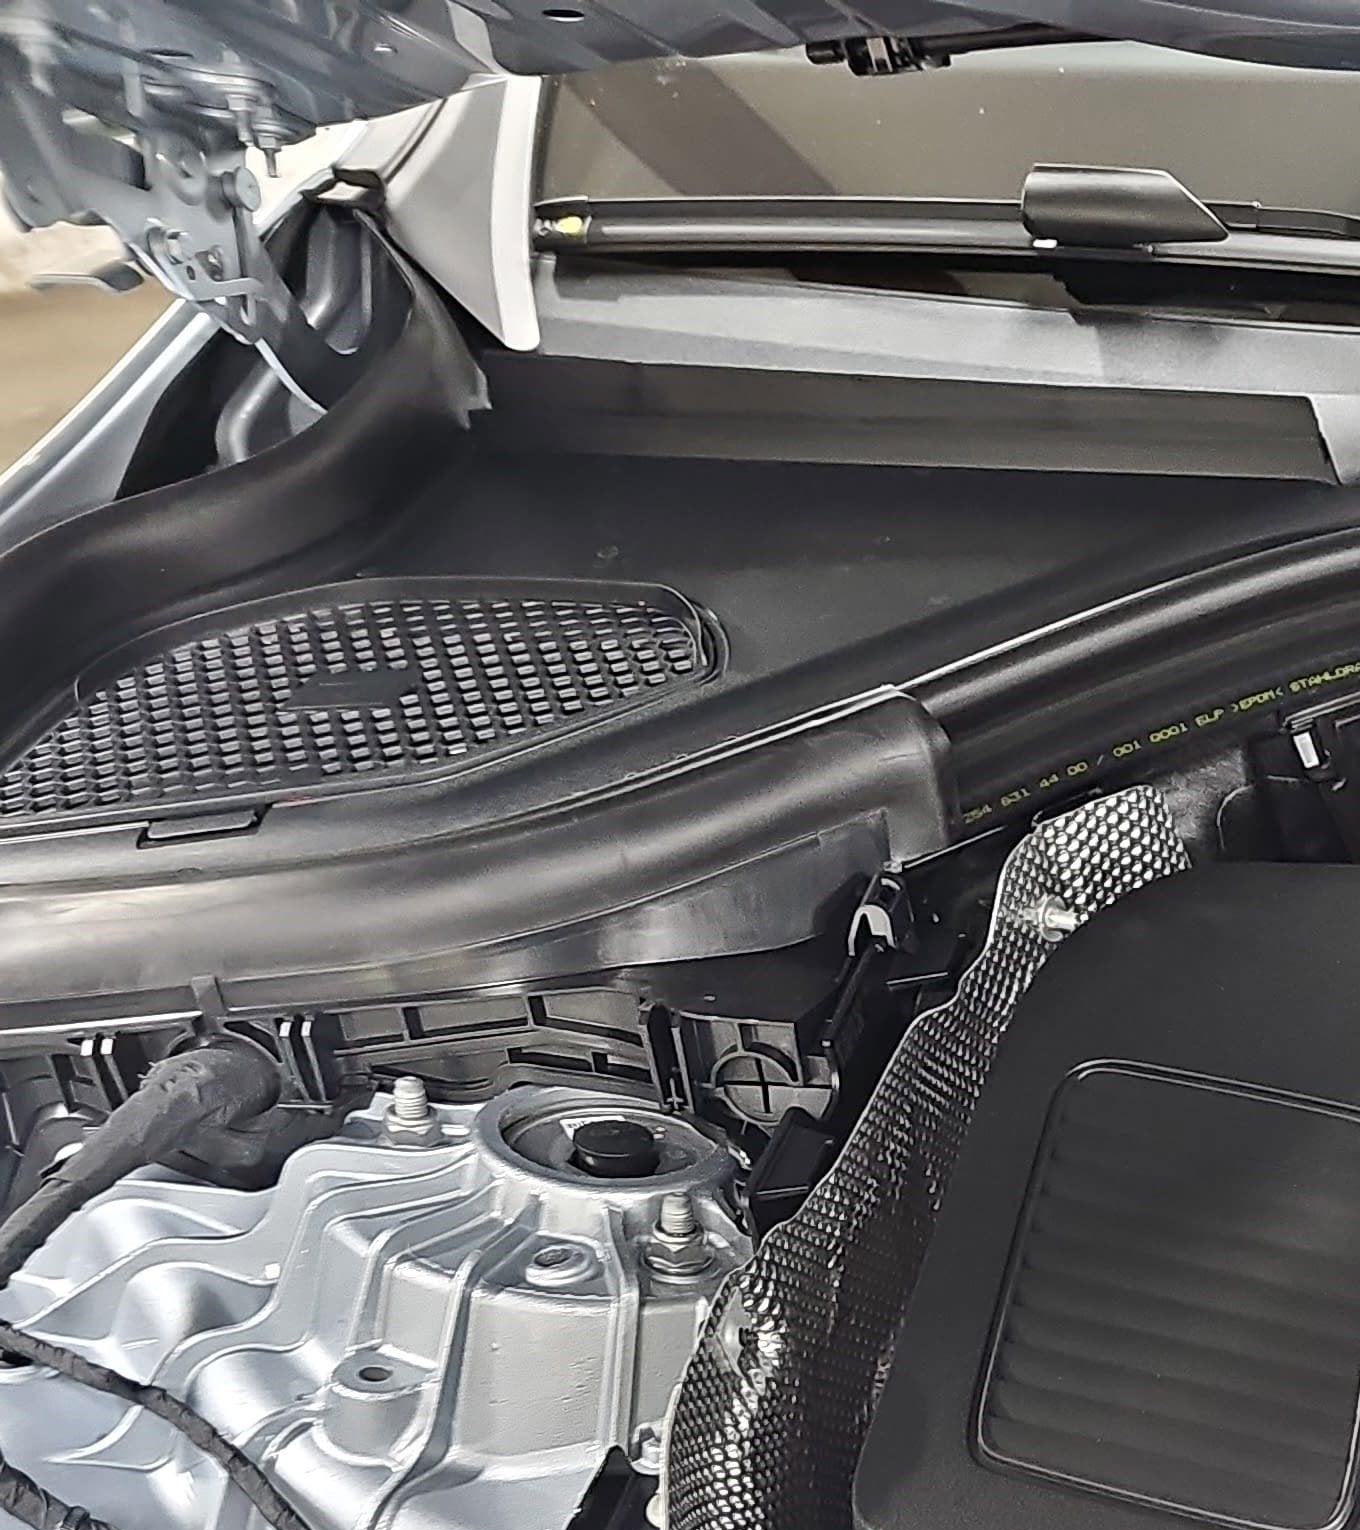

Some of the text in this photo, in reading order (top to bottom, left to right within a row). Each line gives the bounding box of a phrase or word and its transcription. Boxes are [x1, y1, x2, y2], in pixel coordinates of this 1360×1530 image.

[1039, 773, 1060, 788] 44
[1066, 761, 1088, 776] 00
[1112, 739, 1142, 757] 001
[1149, 722, 1188, 743] 0001
